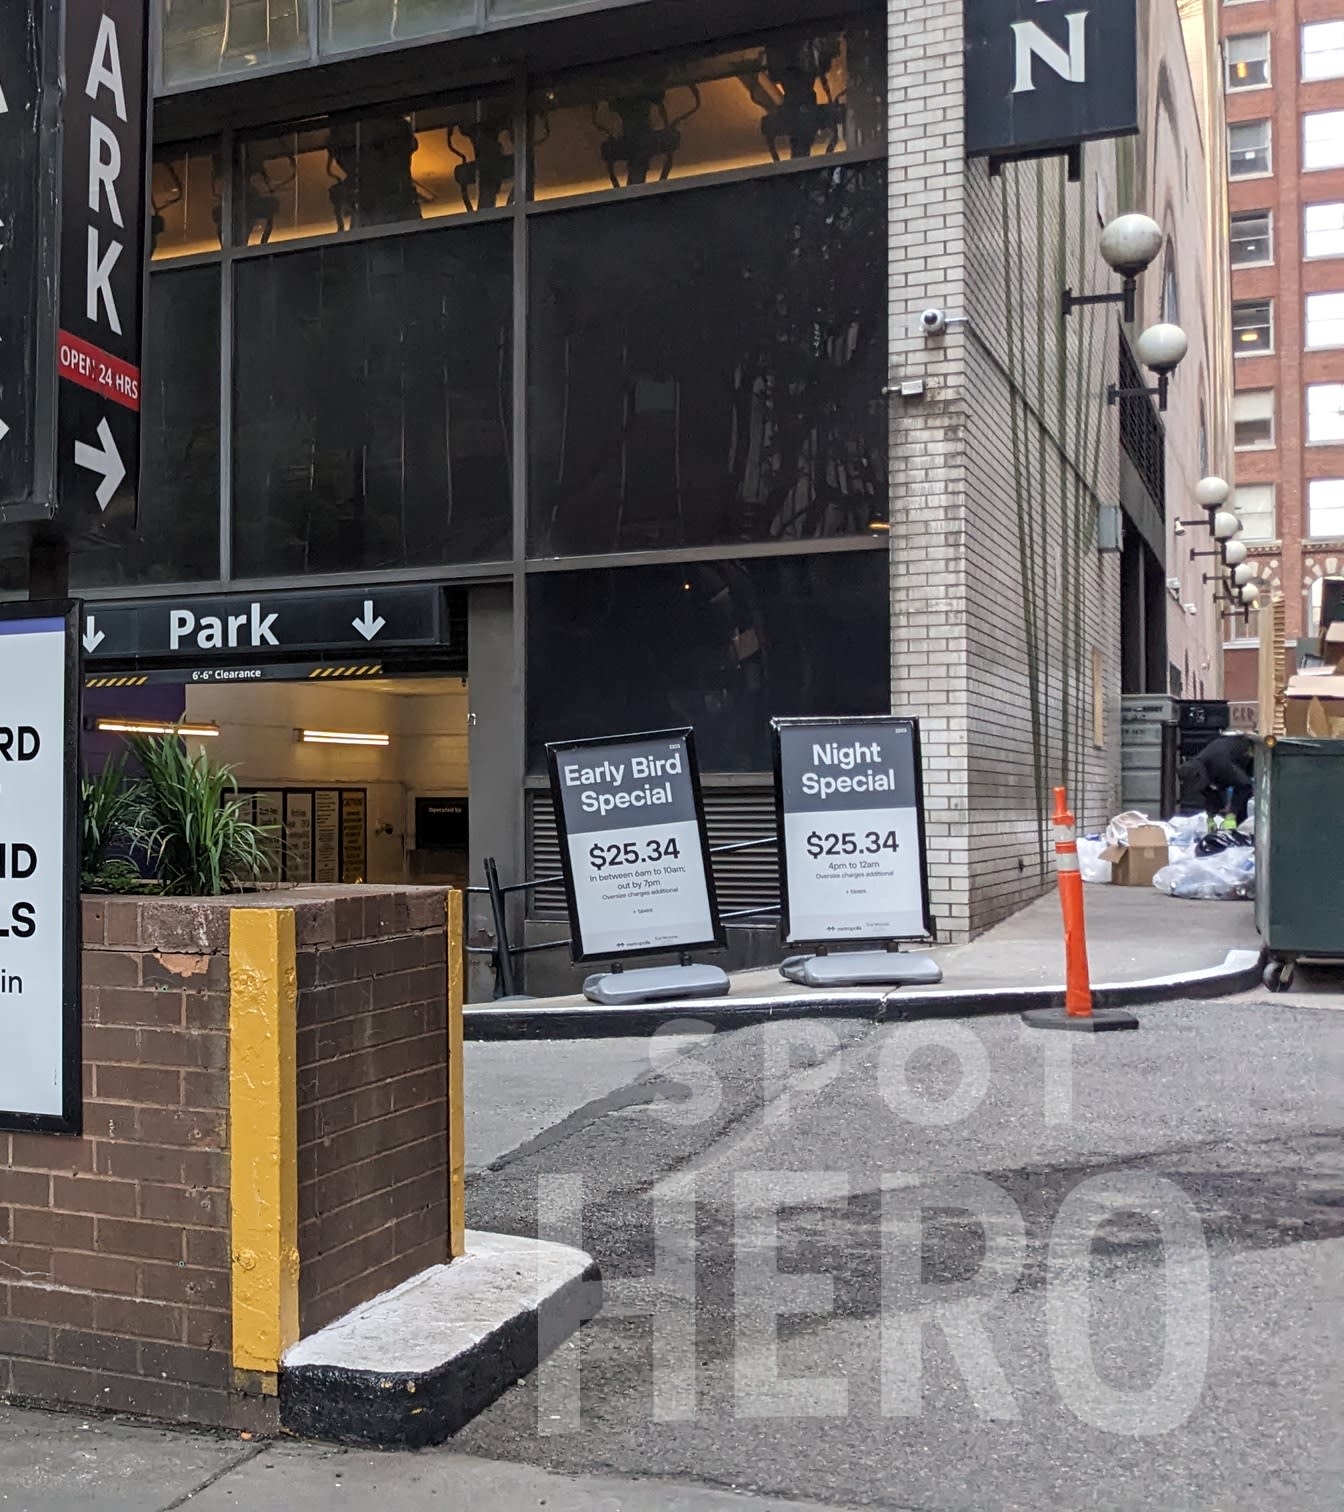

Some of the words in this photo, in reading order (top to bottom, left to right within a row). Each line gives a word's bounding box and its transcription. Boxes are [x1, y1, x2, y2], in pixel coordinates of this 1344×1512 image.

[60, 345, 96, 379] OPEN
[98, 364, 113, 387] 24
[116, 373, 138, 400] HRS
[169, 602, 280, 650] Park
[214, 669, 261, 679] Clearance
[564, 761, 625, 787] Early
[631, 753, 682, 779] Bird
[812, 742, 881, 770] Night
[802, 769, 896, 799] Special
[580, 782, 673, 816] Special
[588, 838, 681, 871] $25.34
[806, 831, 899, 860] $25.34
[599, 872, 633, 882] between
[828, 862, 847, 871] 4pm
[859, 861, 880, 869] 12am
[628, 890, 650, 898] charges
[632, 882, 642, 890] by
[643, 879, 661, 887] 7pm
